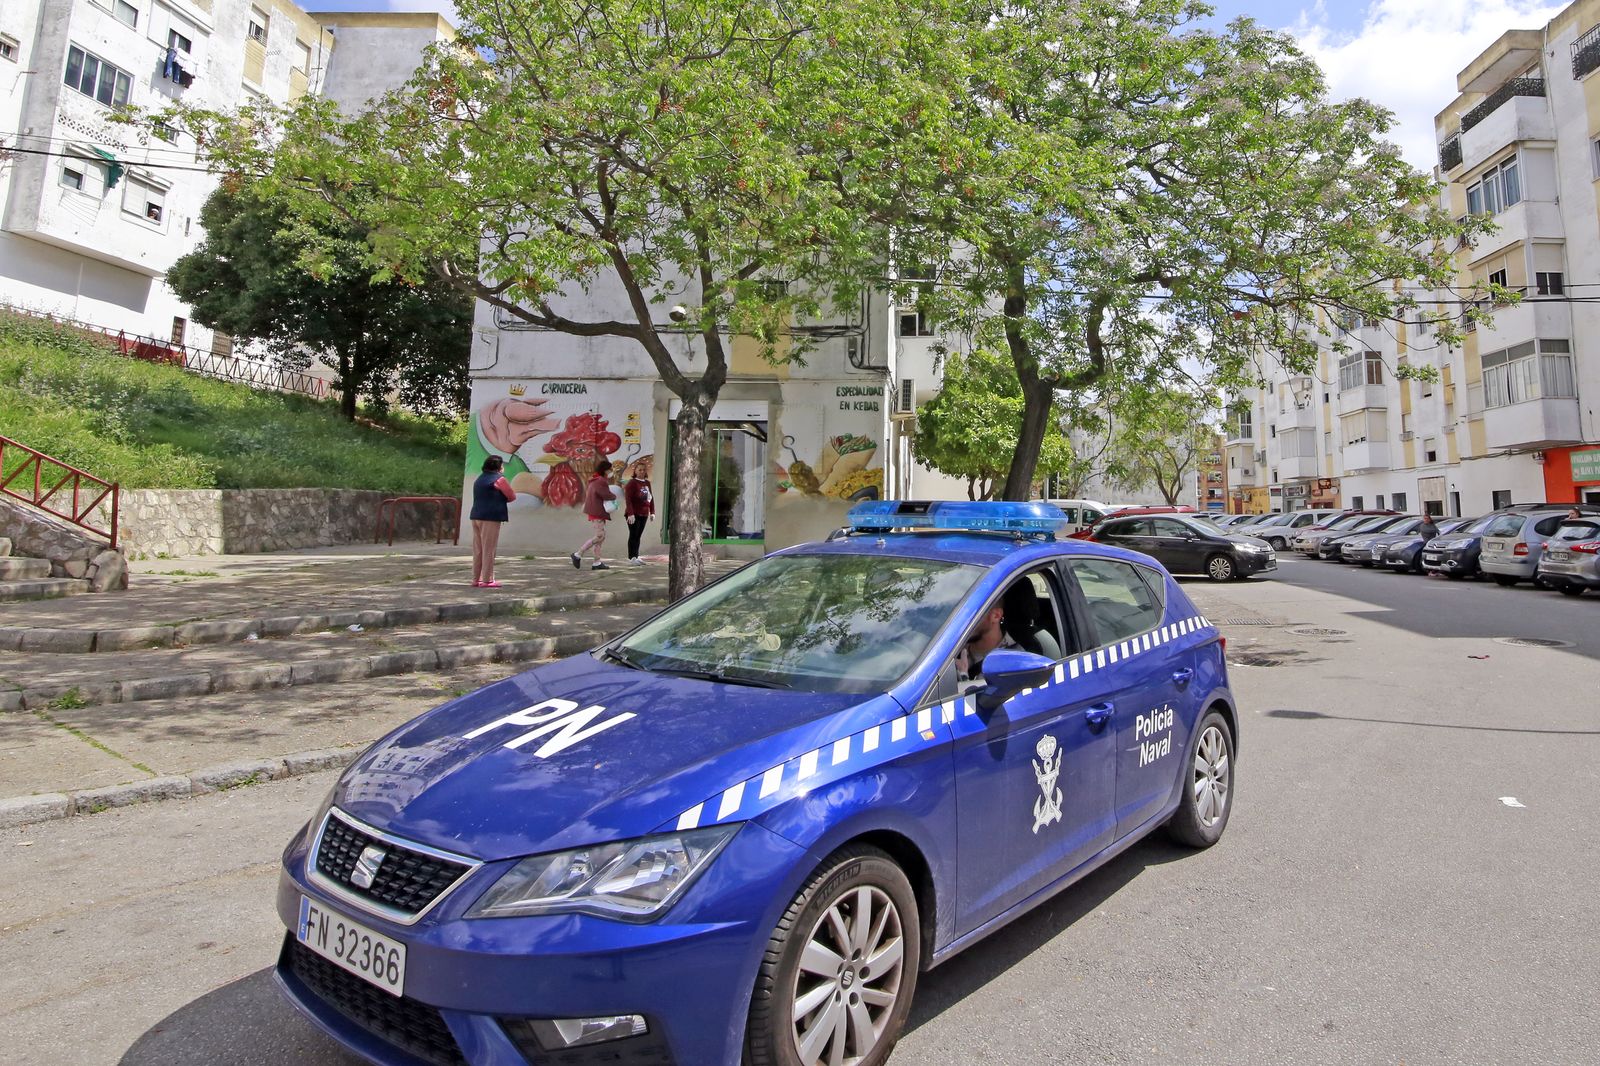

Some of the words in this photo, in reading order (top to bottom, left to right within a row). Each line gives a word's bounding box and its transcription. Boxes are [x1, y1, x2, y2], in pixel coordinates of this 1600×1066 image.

[840, 401, 850, 410] EN
[854, 401, 879, 411] KEBAB
[462, 698, 637, 759] PN
[1135, 704, 1173, 741] Policía
[1139, 730, 1171, 768] Naval
[307, 906, 329, 950] FN
[335, 922, 400, 986] 32366
